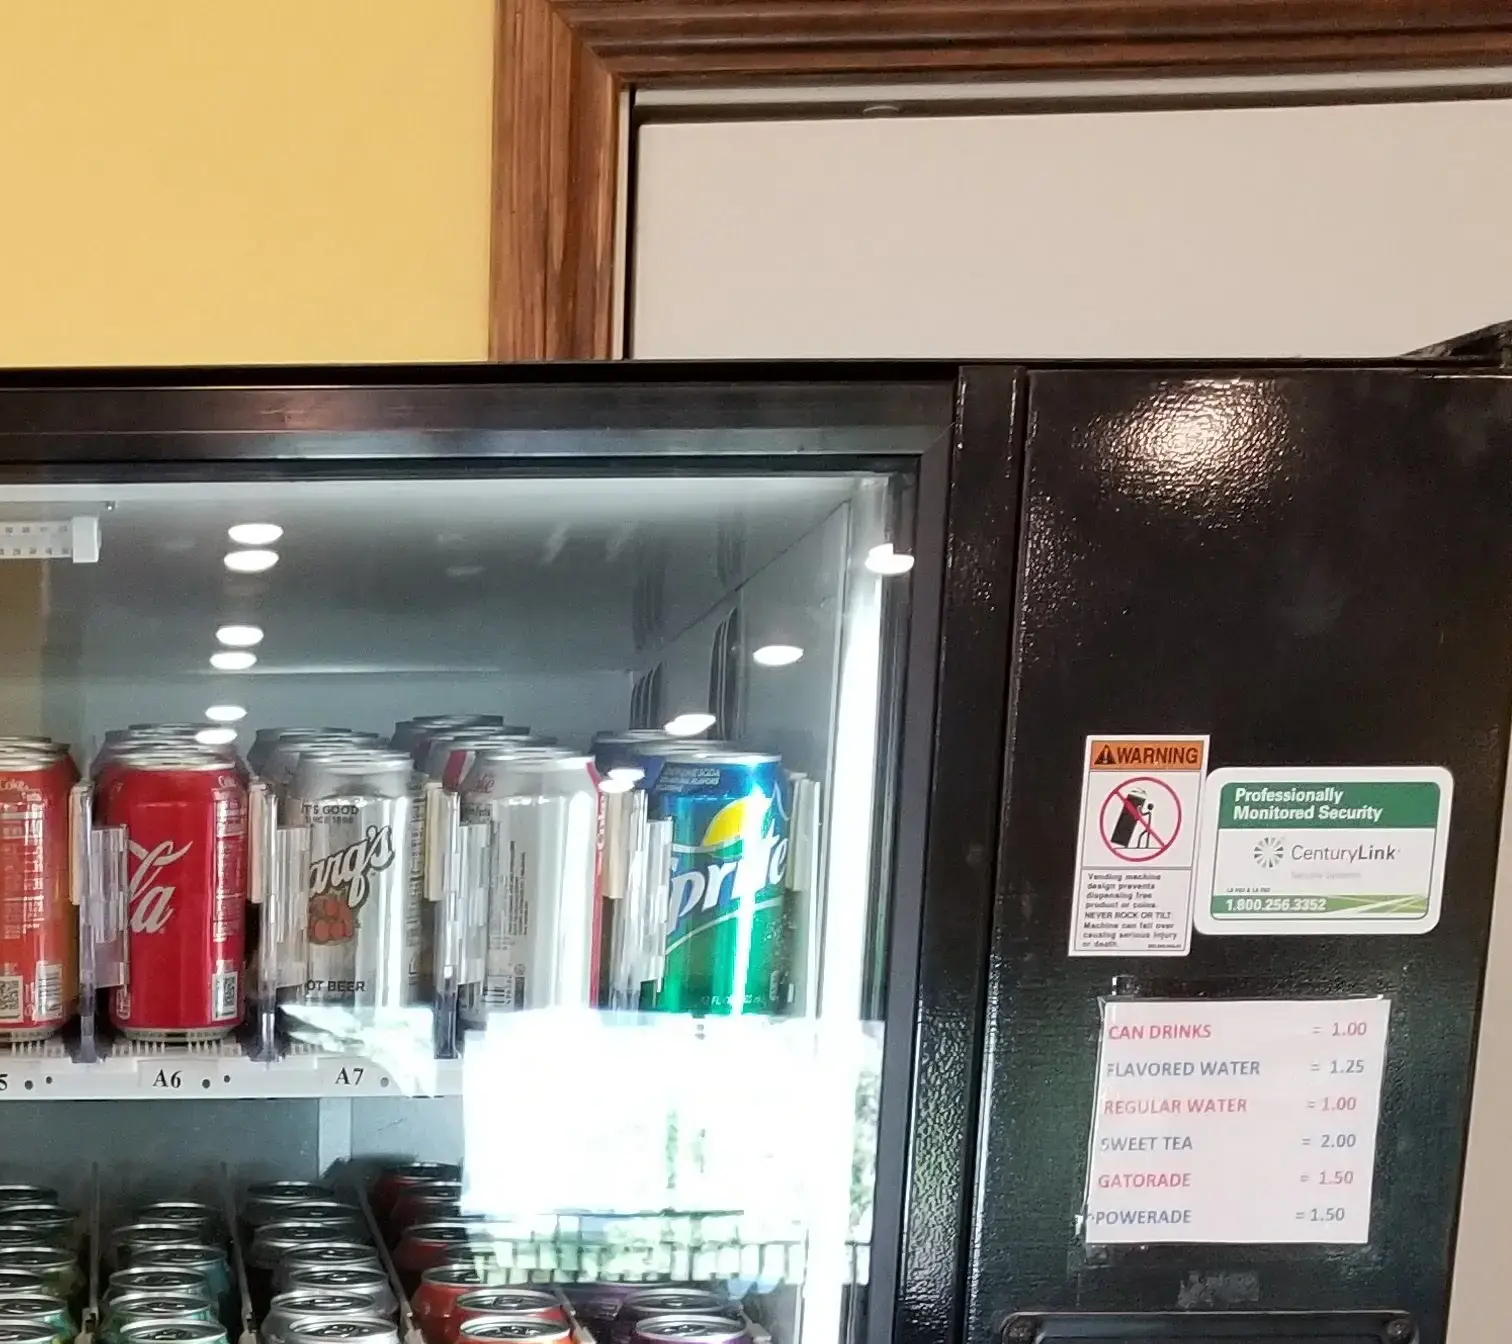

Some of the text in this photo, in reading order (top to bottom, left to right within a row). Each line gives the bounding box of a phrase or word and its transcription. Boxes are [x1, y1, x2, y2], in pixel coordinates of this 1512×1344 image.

[1116, 747, 1198, 765] WARNING
[1235, 788, 1344, 804] Professionally
[323, 805, 359, 815] GOOD
[1233, 805, 1383, 822] Monitored Security
[1291, 845, 1396, 863] CenturyLink
[308, 825, 395, 909] arq's
[1088, 873, 1122, 881] Vending
[1226, 898, 1326, 911] 1.800.256.3352
[1154, 932, 1177, 940] injury
[327, 980, 365, 992] BEER
[1108, 1022, 1367, 1040] CAN DRINKS 1.00
[335, 1067, 364, 1086] A7
[1107, 1060, 1364, 1077] FLAVORED WATER 1.25
[153, 1070, 182, 1089] A6
[1104, 1097, 1356, 1114] REGULAR WATER 1.00
[1100, 1134, 1356, 1151] SWEET TEA 2.00
[1098, 1170, 1354, 1188] GATORADE 1.50
[1095, 1208, 1345, 1224] POWERADE 1.50
